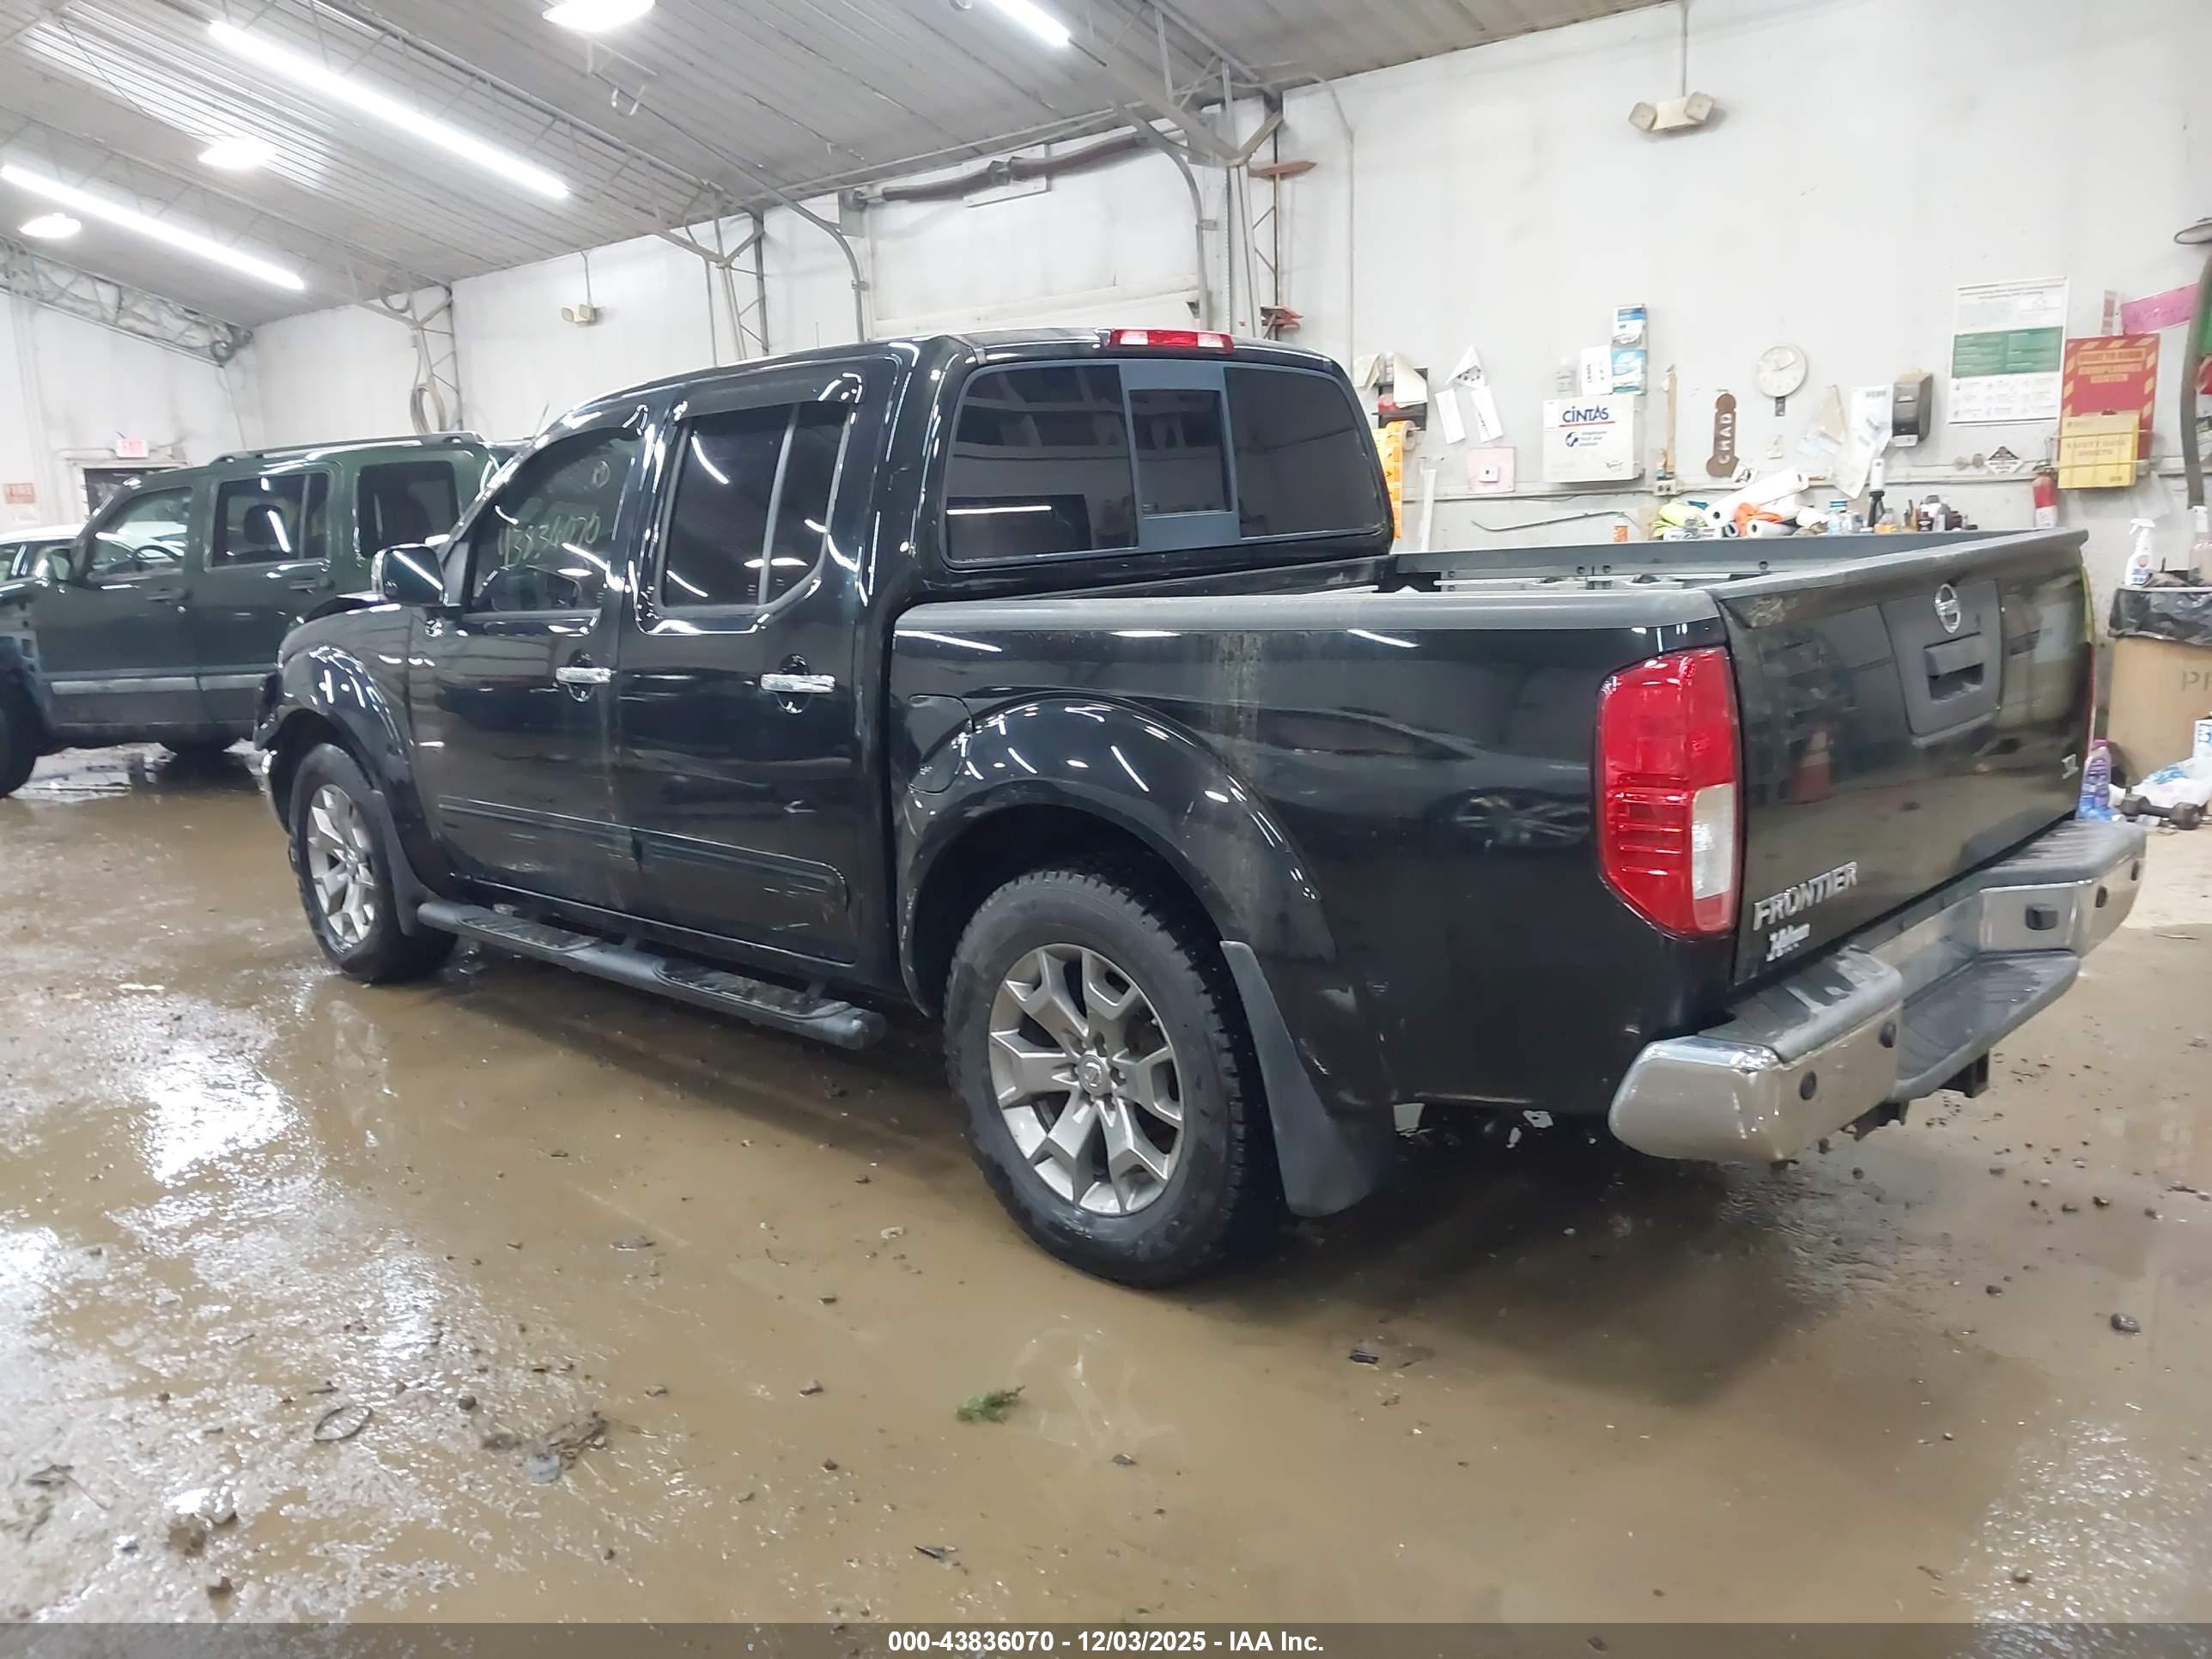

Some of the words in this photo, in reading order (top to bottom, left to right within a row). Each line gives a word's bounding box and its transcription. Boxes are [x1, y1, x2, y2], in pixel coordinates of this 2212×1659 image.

[1562, 405, 1610, 423] CINTAS
[1717, 412, 1733, 465] CHAD
[1753, 861, 1858, 931] FRONTIER
